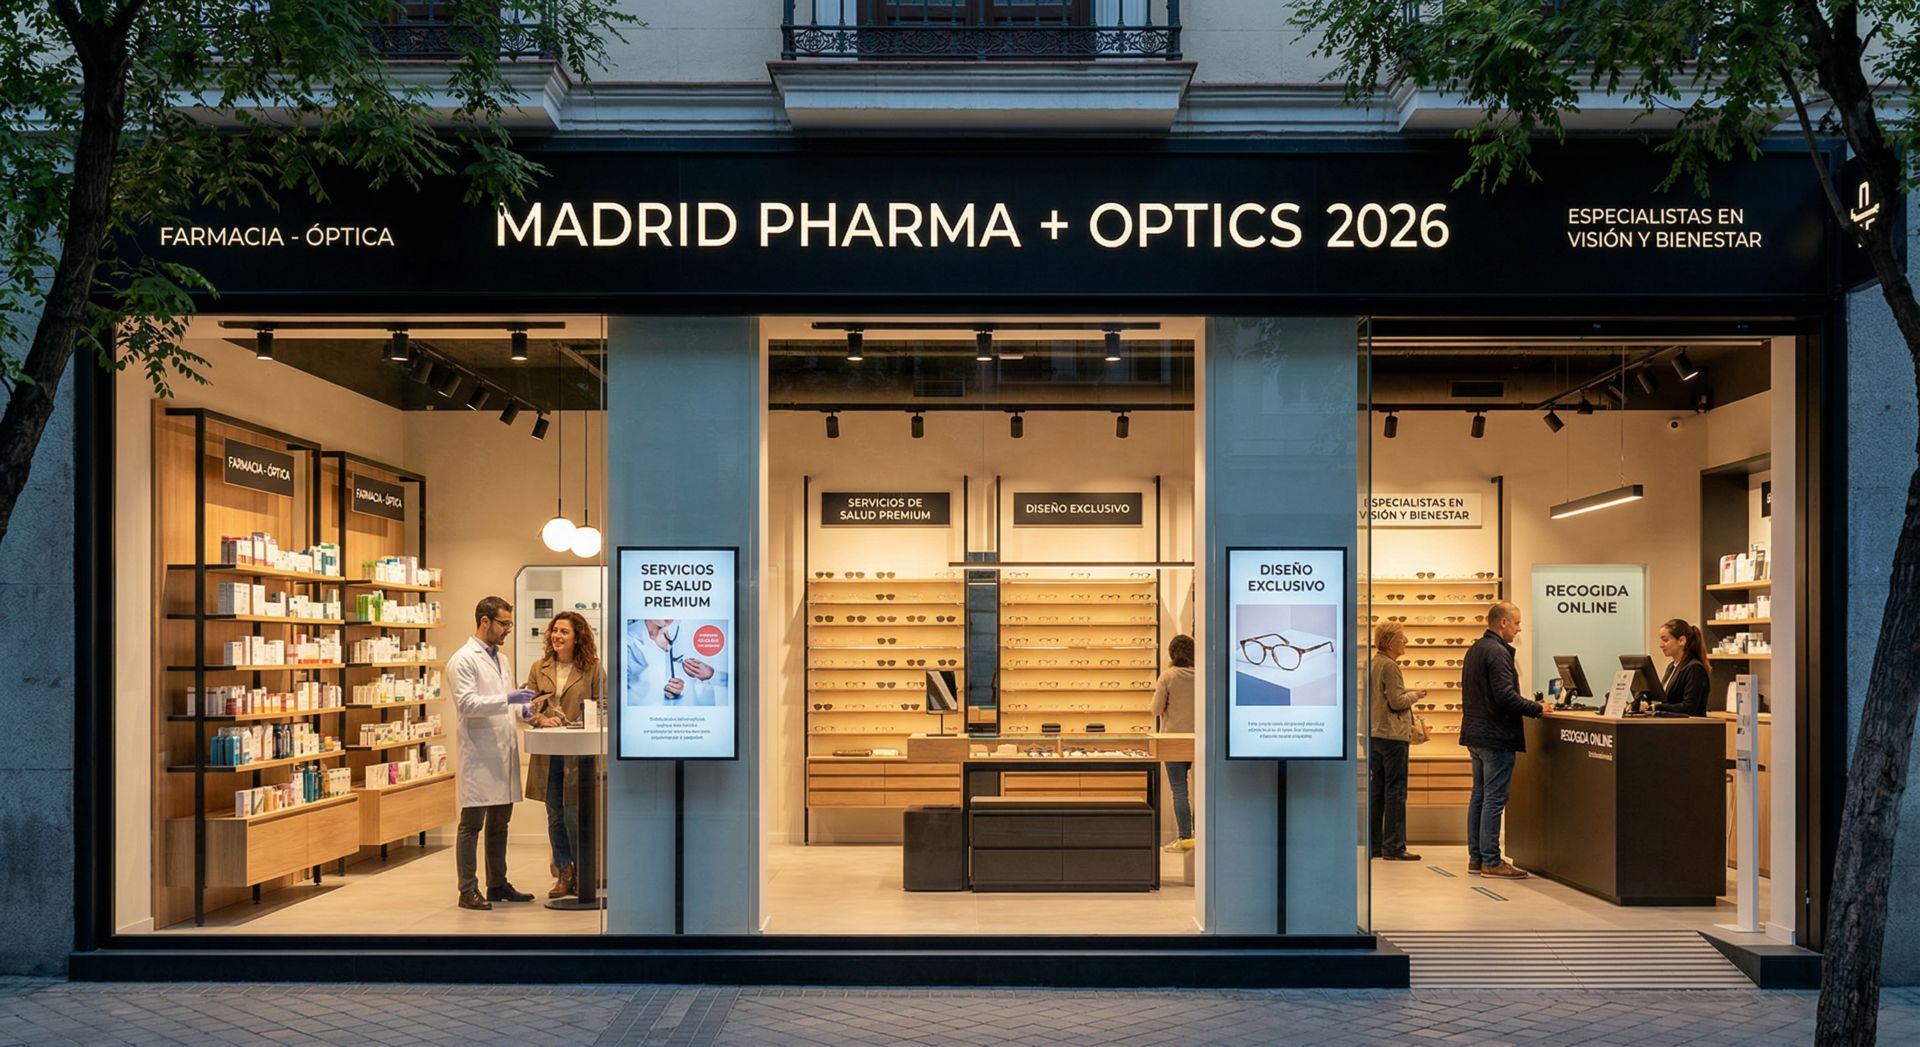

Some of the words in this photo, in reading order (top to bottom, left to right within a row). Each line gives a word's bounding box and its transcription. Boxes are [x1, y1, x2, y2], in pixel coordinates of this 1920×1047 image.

[1568, 208, 1713, 225] ESPECIALISTAS
[1718, 208, 1744, 225] EN
[496, 201, 738, 248] MADRID
[760, 202, 1022, 248] PHARMA
[1040, 209, 1069, 240] +
[1089, 202, 1302, 248] OPTICS
[1326, 202, 1450, 248] 2026
[160, 227, 285, 246] FARMACIA
[305, 222, 395, 246] ÓPTICA
[1567, 228, 1633, 248] VISIÓN
[1637, 231, 1651, 248] Y
[1656, 231, 1762, 248] BIENESTAR
[848, 498, 905, 508] SERVICIOS
[907, 498, 923, 508] DE
[1026, 502, 1067, 514] DISEÑO
[1070, 503, 1130, 514] EXCLUSIVO
[1448, 498, 1464, 508] EN
[839, 510, 877, 520] SALUD
[879, 510, 931, 520] PREMIUM
[1359, 509, 1397, 520] VSIÓN
[1399, 511, 1407, 520] Y
[1409, 511, 1470, 520] BIENESTAR
[641, 564, 714, 576] SERVICIOS
[1260, 562, 1313, 576] DISEÑO
[643, 580, 662, 591] DE
[665, 580, 712, 591] SALUD
[1248, 580, 1325, 592] EXCLUSIVO
[1545, 584, 1629, 597] RECOGIDA
[644, 596, 711, 608] PREMIUM
[1557, 601, 1618, 614] ONLINE
